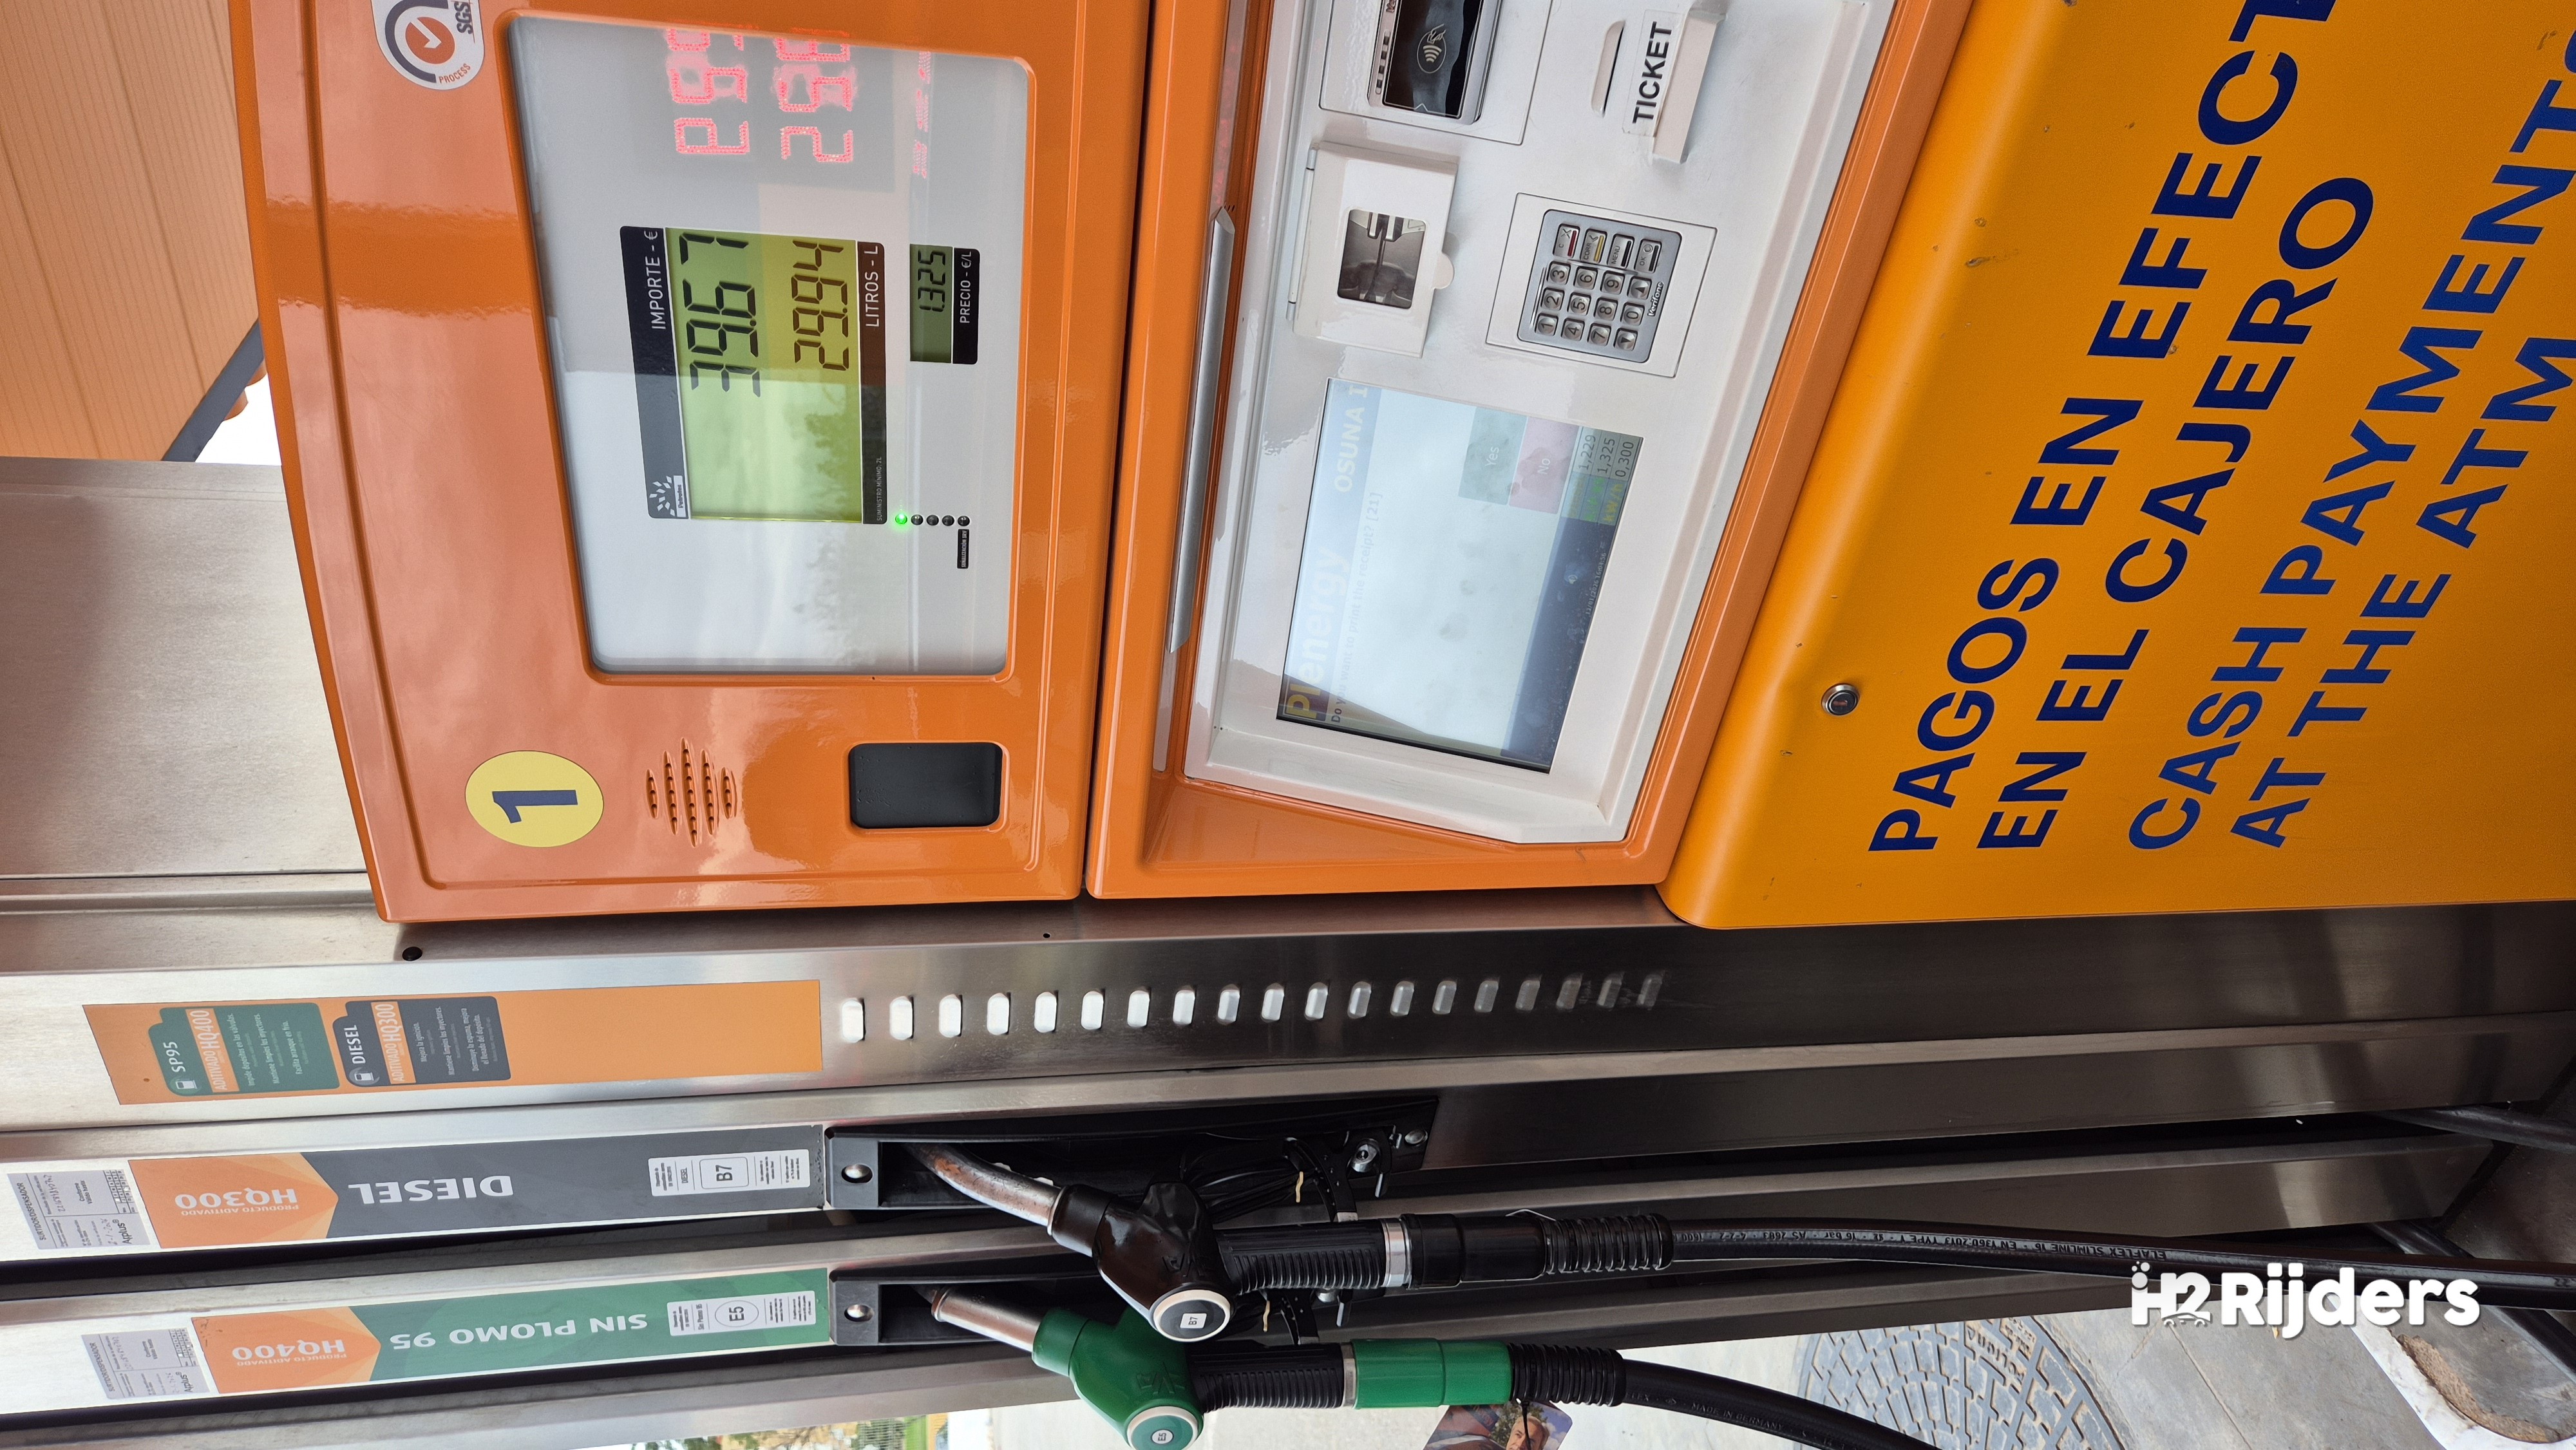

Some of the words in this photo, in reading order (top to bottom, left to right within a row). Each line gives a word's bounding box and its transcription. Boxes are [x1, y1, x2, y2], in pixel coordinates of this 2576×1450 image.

[453, 1, 473, 34] SGS
[439, 63, 471, 84] PROCESS
[1632, 21, 1673, 124] TICKET
[644, 230, 658, 241] €
[864, 246, 878, 255] L
[960, 251, 972, 268] €/L
[1583, 242, 1592, 260] CORR
[1611, 245, 1621, 264] MENU
[1639, 256, 1647, 266] OK
[918, 251, 946, 312] 1.325
[1552, 270, 1565, 278] 3
[645, 257, 666, 330] IMPORTE
[865, 272, 880, 327] LITROS
[961, 280, 971, 323] PRECIO
[1546, 296, 1559, 304] 2
[1647, 281, 1664, 317] Verifone
[679, 232, 761, 397] 39.67
[791, 240, 849, 372] 29.94
[1599, 306, 1611, 314] 8
[1333, 407, 1366, 493] OSUNA
[2128, 627, 2307, 850] CASH
[2259, 30, 2576, 596] PAYMENT
[1484, 447, 1500, 466] Yes
[1578, 435, 1596, 470] 1,229
[1597, 437, 1615, 474] 1,325
[1615, 442, 1634, 477] 0,300
[1537, 458, 1550, 474] No
[1364, 492, 1383, 522] [21]
[1977, 751, 2087, 850] EN
[2036, 629, 2149, 722] EL
[2105, 177, 2375, 604] CAJERO
[1354, 525, 1376, 577] receipt?
[1350, 579, 1365, 600] the
[2230, 756, 2326, 849] AT
[2289, 572, 2452, 737] THE
[2415, 337, 2576, 550] ATM
[1346, 604, 1363, 634] print
[1868, 557, 2060, 852] PAGOS
[2011, 395, 2143, 527] EN
[1287, 547, 1350, 719] Plenergy
[1343, 636, 1356, 648] to
[1340, 652, 1353, 680] want
[1335, 685, 1348, 705] you
[1331, 708, 1343, 722] Do
[491, 789, 578, 824] 1
[227, 1013, 238, 1033] válvulas.
[254, 1013, 267, 1037] inyectores.
[375, 1004, 402, 1042] HQ300
[435, 1006, 446, 1030] inyectores.
[460, 1008, 470, 1024] mejora
[190, 1010, 220, 1050] HQ400
[287, 1037, 298, 1058] arranque
[343, 1024, 366, 1064] DIESEL
[441, 1038, 451, 1055] limpios
[478, 1042, 488, 1059] llenado
[163, 1041, 186, 1073] SP95
[238, 1048, 251, 1069] depósitos
[263, 1046, 274, 1063] limpios
[384, 1043, 405, 1082] ADITIVADO
[419, 1047, 428, 1062] Mejora
[469, 1049, 479, 1071] Disminuye
[203, 1050, 227, 1090] ADITIVADO
[267, 1063, 279, 1084] Mantiene
[292, 1059, 303, 1074] Facilita
[446, 1055, 455, 1075] Mantiene
[244, 1070, 256, 1086] Impide
[715, 1165, 733, 1182] B7
[74, 1183, 85, 1201] Conforme
[174, 1187, 298, 1209] HQ300
[348, 1174, 513, 1204] DIESEL
[17, 1183, 46, 1240] SURTIDOR/DISPENSADOR
[181, 1207, 239, 1216] ADITIVADO
[242, 1204, 299, 1214] PRODUCTO
[1682, 1232, 1703, 1241] 1600
[1719, 1232, 1748, 1241] 4-2-2
[1792, 1232, 1806, 1241] AS
[1824, 1232, 1842, 1241] bar
[1909, 1234, 1938, 1246] TYPE
[1944, 1237, 1998, 1250] 1360:2013
[2000, 1240, 2017, 1250] EN
[2034, 1243, 2046, 1253] 16
[2051, 1243, 2104, 1257] SLIMLINE
[2108, 1247, 2167, 1259] ELAFLEX
[590, 1313, 648, 1333] SIN
[728, 1306, 744, 1321] E5
[1188, 1316, 1198, 1325] B7
[389, 1332, 437, 1350] 95
[449, 1321, 576, 1344] PLOMO
[231, 1339, 346, 1361] HQ400
[294, 1353, 347, 1363] PRODUCTO
[90, 1342, 115, 1392] SURTIDOR/DISPENSADOR
[236, 1357, 290, 1366] ADITIVADO
[1690, 1402, 1719, 1415] MADE
[1736, 1413, 1785, 1431] GERMANY
[1158, 1432, 1166, 1441] E5
